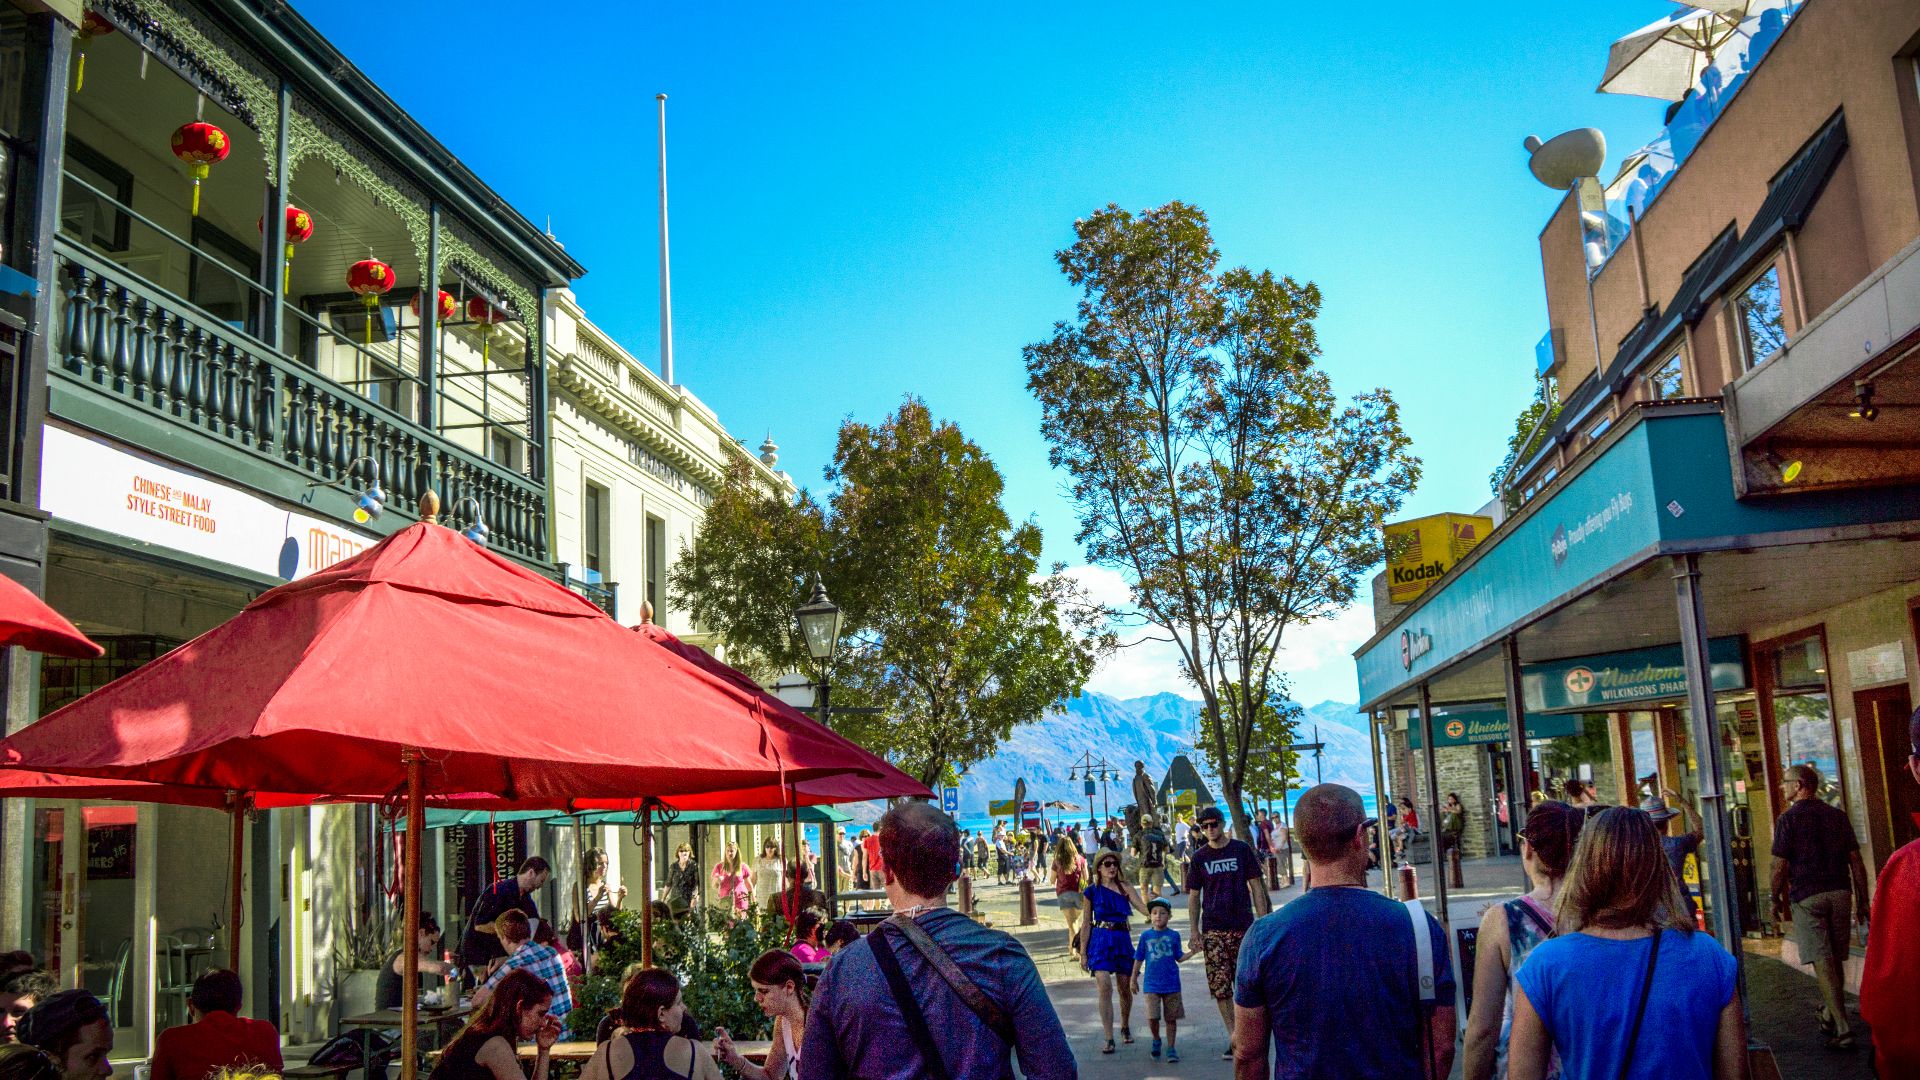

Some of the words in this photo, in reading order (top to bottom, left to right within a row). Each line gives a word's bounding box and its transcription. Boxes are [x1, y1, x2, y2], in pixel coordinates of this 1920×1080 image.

[133, 475, 172, 502] CHINESE
[182, 491, 212, 514] MALAY
[127, 493, 156, 517] STYLE
[158, 503, 193, 527] STREET
[193, 514, 216, 534] FOOD
[308, 527, 364, 570] man
[1393, 560, 1446, 584] Kodak
[1602, 664, 1681, 688] Unichem
[1601, 683, 1658, 700] WILKINSONS
[1660, 680, 1689, 693] PHAR
[1468, 719, 1510, 734] Uniche
[507, 822, 515, 863] ZEALAND
[1204, 857, 1239, 875] VANS
